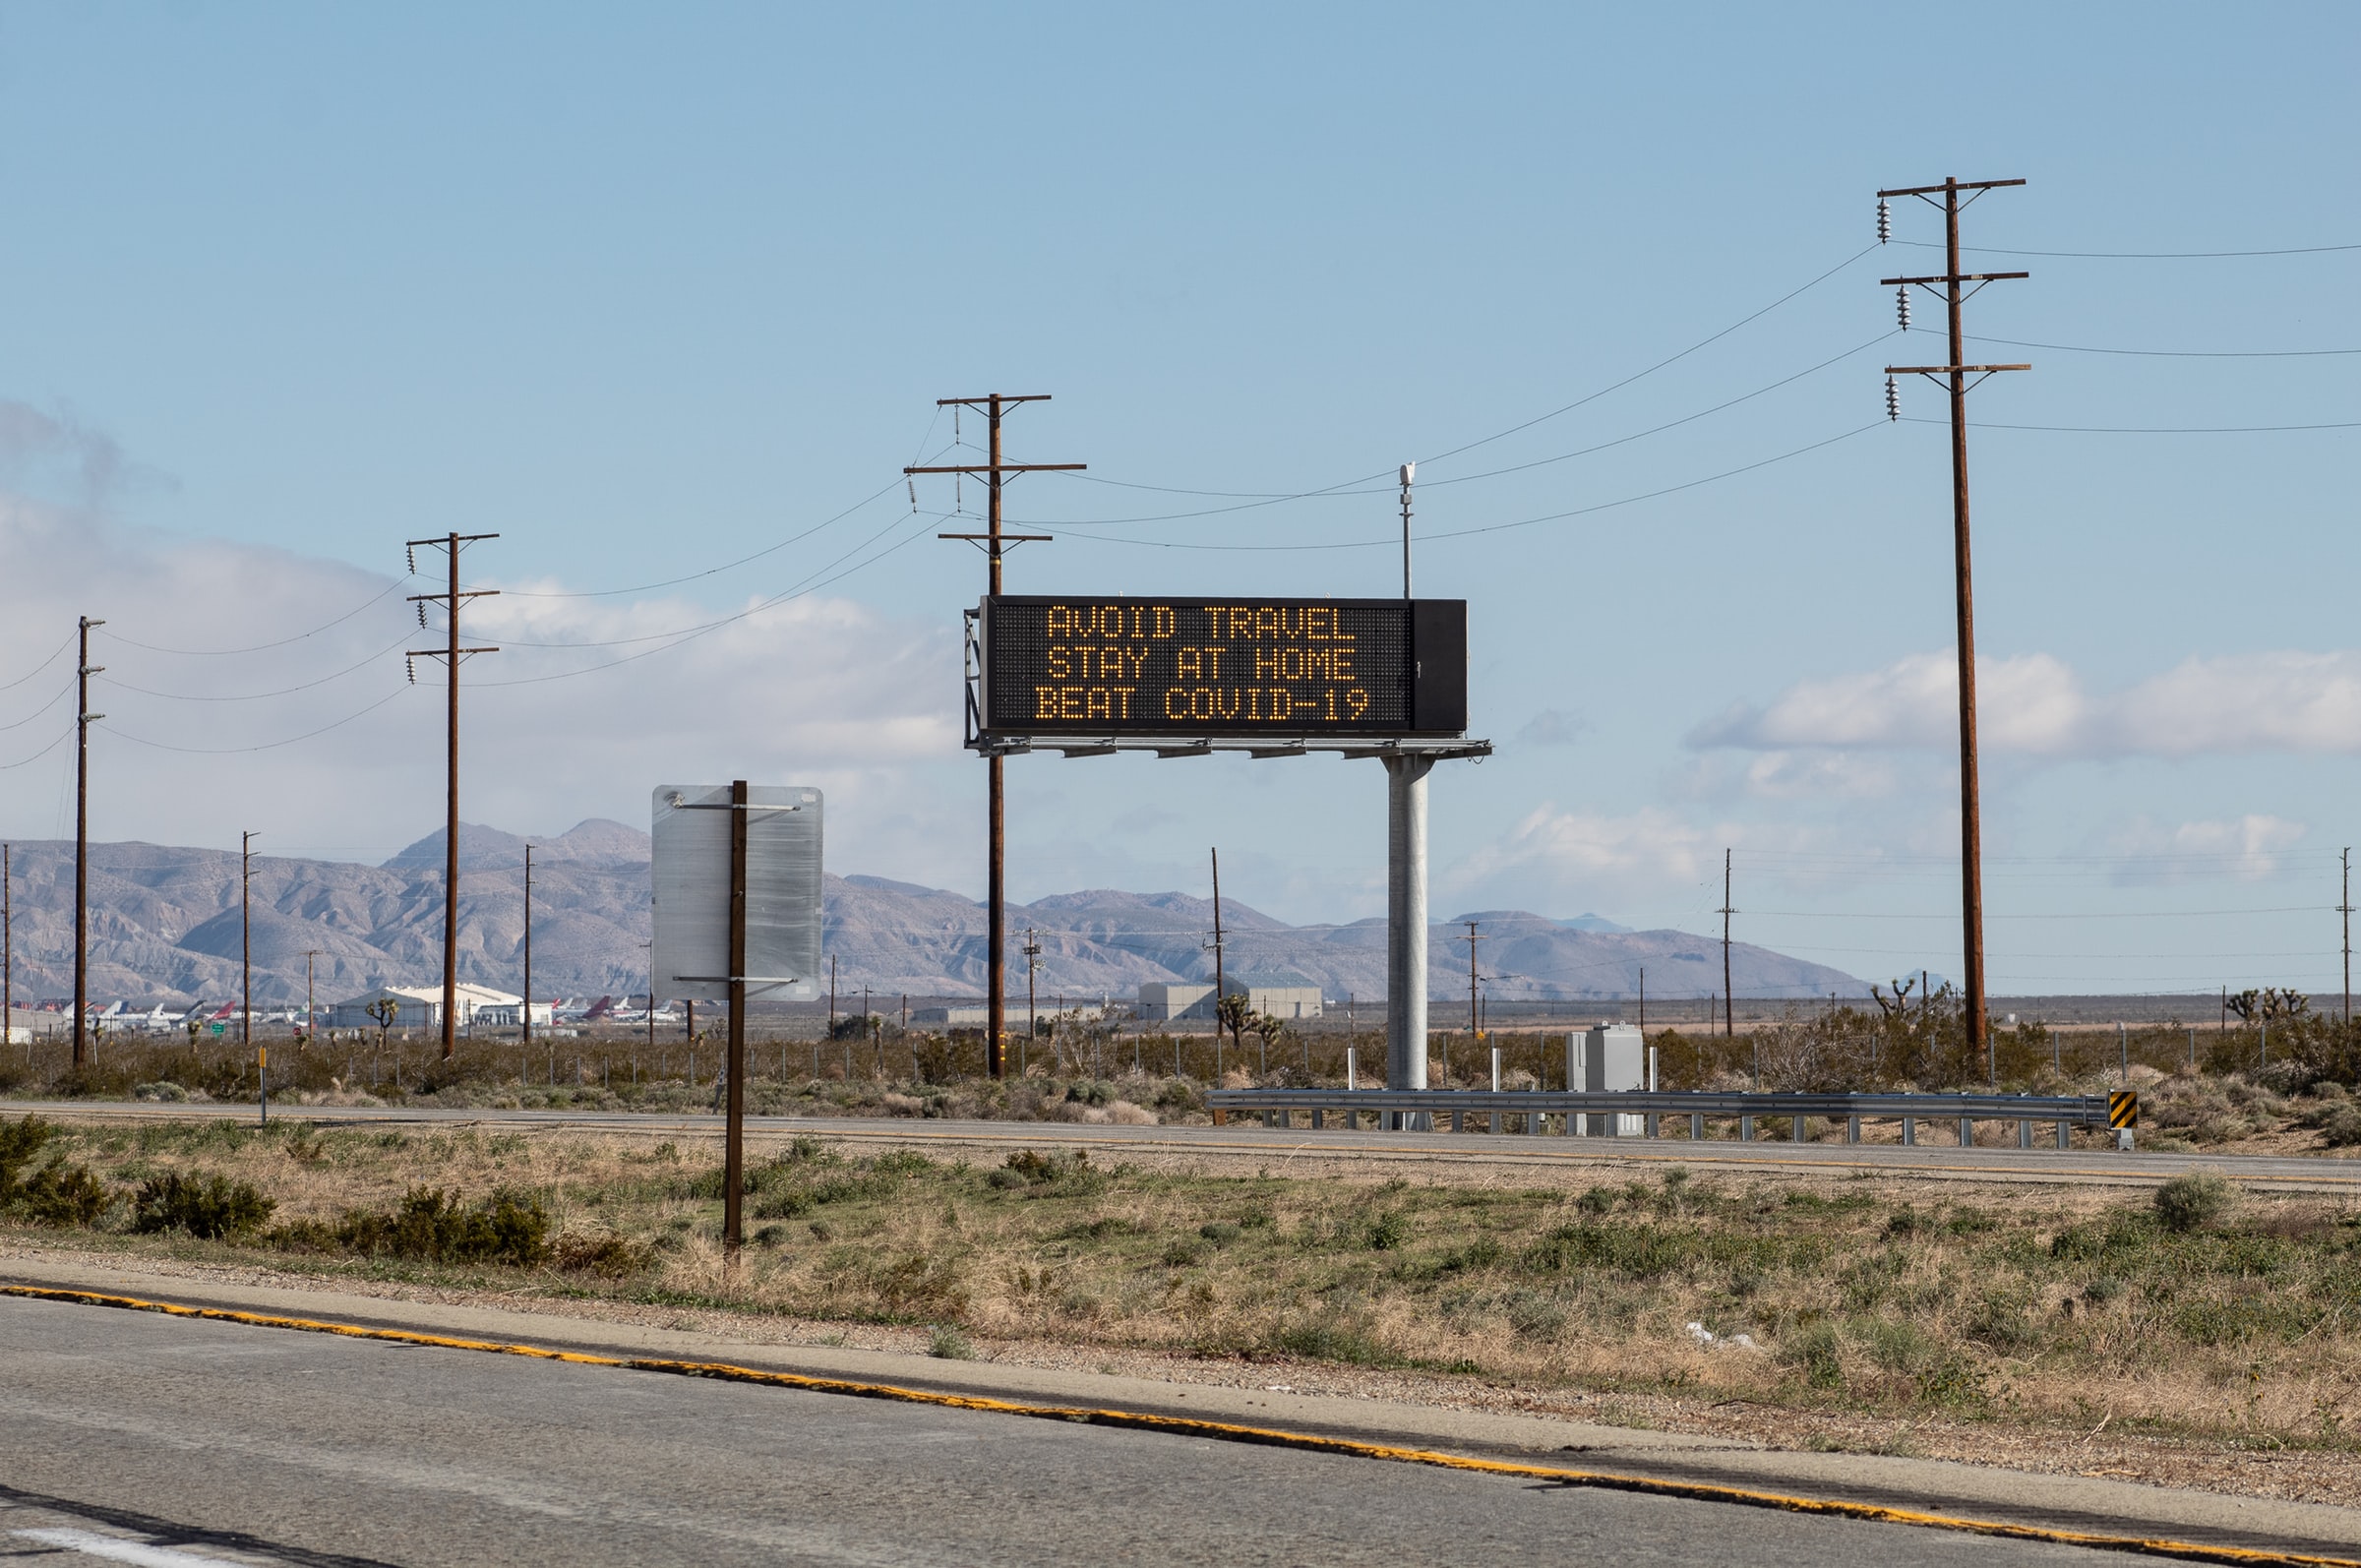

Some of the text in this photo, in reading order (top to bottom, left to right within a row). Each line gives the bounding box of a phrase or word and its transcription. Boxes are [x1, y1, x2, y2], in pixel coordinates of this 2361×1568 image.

[1049, 606, 1354, 639] AVOID TRAVEL
[1049, 646, 1355, 680] STAY AT HOME
[1036, 688, 1367, 720] BEAT COVID-19
